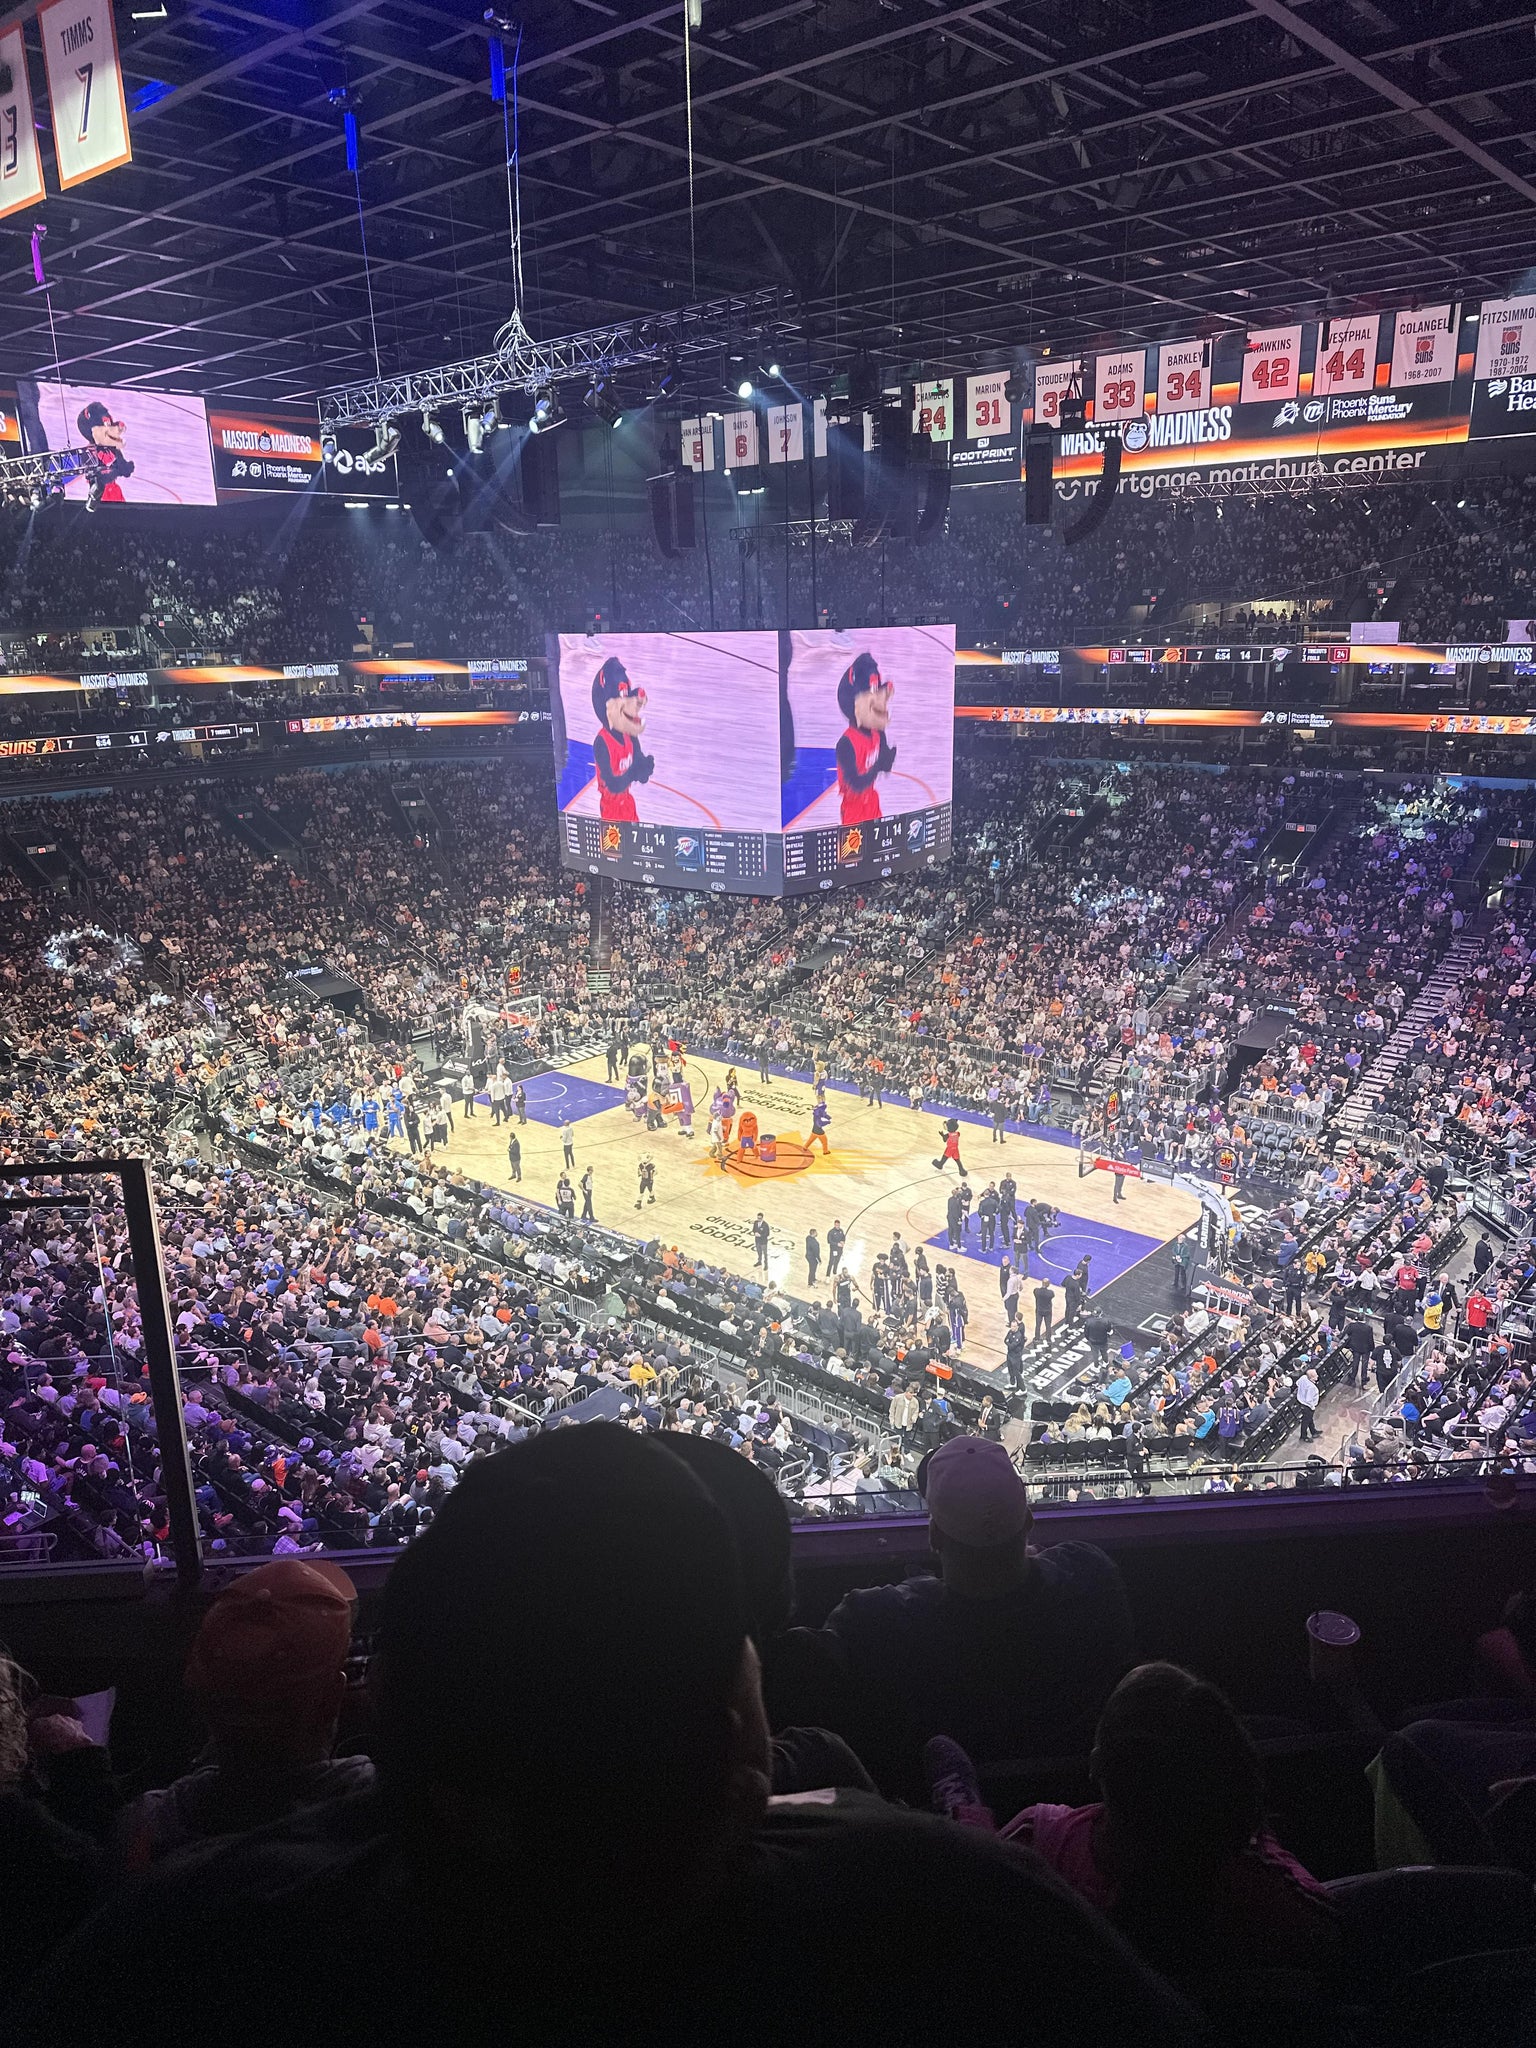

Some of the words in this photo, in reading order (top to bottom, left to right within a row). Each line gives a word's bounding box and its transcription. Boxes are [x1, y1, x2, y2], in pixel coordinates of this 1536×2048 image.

[60, 16, 94, 56] TIMMS
[75, 62, 94, 143] 7
[1482, 307, 1536, 326] FITZSIMMO
[1400, 317, 1453, 335] COLANGEL
[1167, 352, 1204, 367] BARKLEY
[1325, 348, 1365, 382] 44
[1490, 355, 1529, 368] 1970-1972
[1108, 363, 1133, 376] ADAMS
[1251, 357, 1290, 390] 42
[1404, 367, 1442, 381] 1968-2007
[1489, 364, 1528, 377] 1987-2004
[1037, 372, 1082, 387] STOUDEM
[1166, 370, 1202, 401] 34
[975, 383, 1001, 395] MARION
[1103, 380, 1136, 410] 33
[1332, 397, 1367, 409] Phoenix
[1369, 394, 1396, 406] Suns
[975, 399, 1001, 427] 31
[1332, 407, 1367, 419] Phoenix
[1367, 402, 1413, 416] Mercury
[1367, 411, 1406, 422] FOUNDATION
[733, 420, 749, 431] DAVIS
[773, 413, 798, 425] JOHNSON
[920, 405, 946, 433] 24
[1150, 406, 1232, 448] MADNESS
[222, 429, 260, 450] MASCOT
[271, 433, 312, 454] MADNESS
[735, 435, 748, 458] 6
[779, 429, 791, 453] 7
[692, 441, 703, 463] 5
[953, 447, 1015, 462] FOOTPRINT
[1085, 470, 1201, 498] mrtgage
[1334, 450, 1426, 474] center
[1001, 651, 1024, 664] MASCOT
[1032, 651, 1059, 664] MADNESS
[1197, 651, 1202, 660] 7
[1215, 652, 1230, 660] 6:54
[1240, 650, 1250, 660] 14
[1337, 651, 1345, 659] 24
[1446, 647, 1481, 662] MASCOT
[1491, 647, 1533, 662] MADNESS
[283, 665, 305, 678] MASCOT
[313, 664, 339, 677] MADNESS
[467, 661, 492, 672] MASCOT
[499, 660, 528, 672] MADNESS
[80, 675, 108, 689] MASCOT
[116, 672, 149, 686] MADNESS
[95, 738, 111, 747] 6:54
[129, 735, 140, 744] 14
[172, 729, 197, 741] THUNDER
[67, 740, 73, 750] 7
[1300, 770, 1314, 778] Bell
[631, 831, 638, 843] 7
[874, 827, 880, 840] 7
[893, 823, 902, 836] 14
[653, 833, 665, 846] 14
[641, 845, 654, 854] 6:54
[743, 1089, 801, 1108] matchup
[773, 1091, 804, 1101] center
[739, 1096, 806, 1116] mortgag
[706, 1216, 774, 1242] atchup
[1028, 1350, 1084, 1390] RIVER
